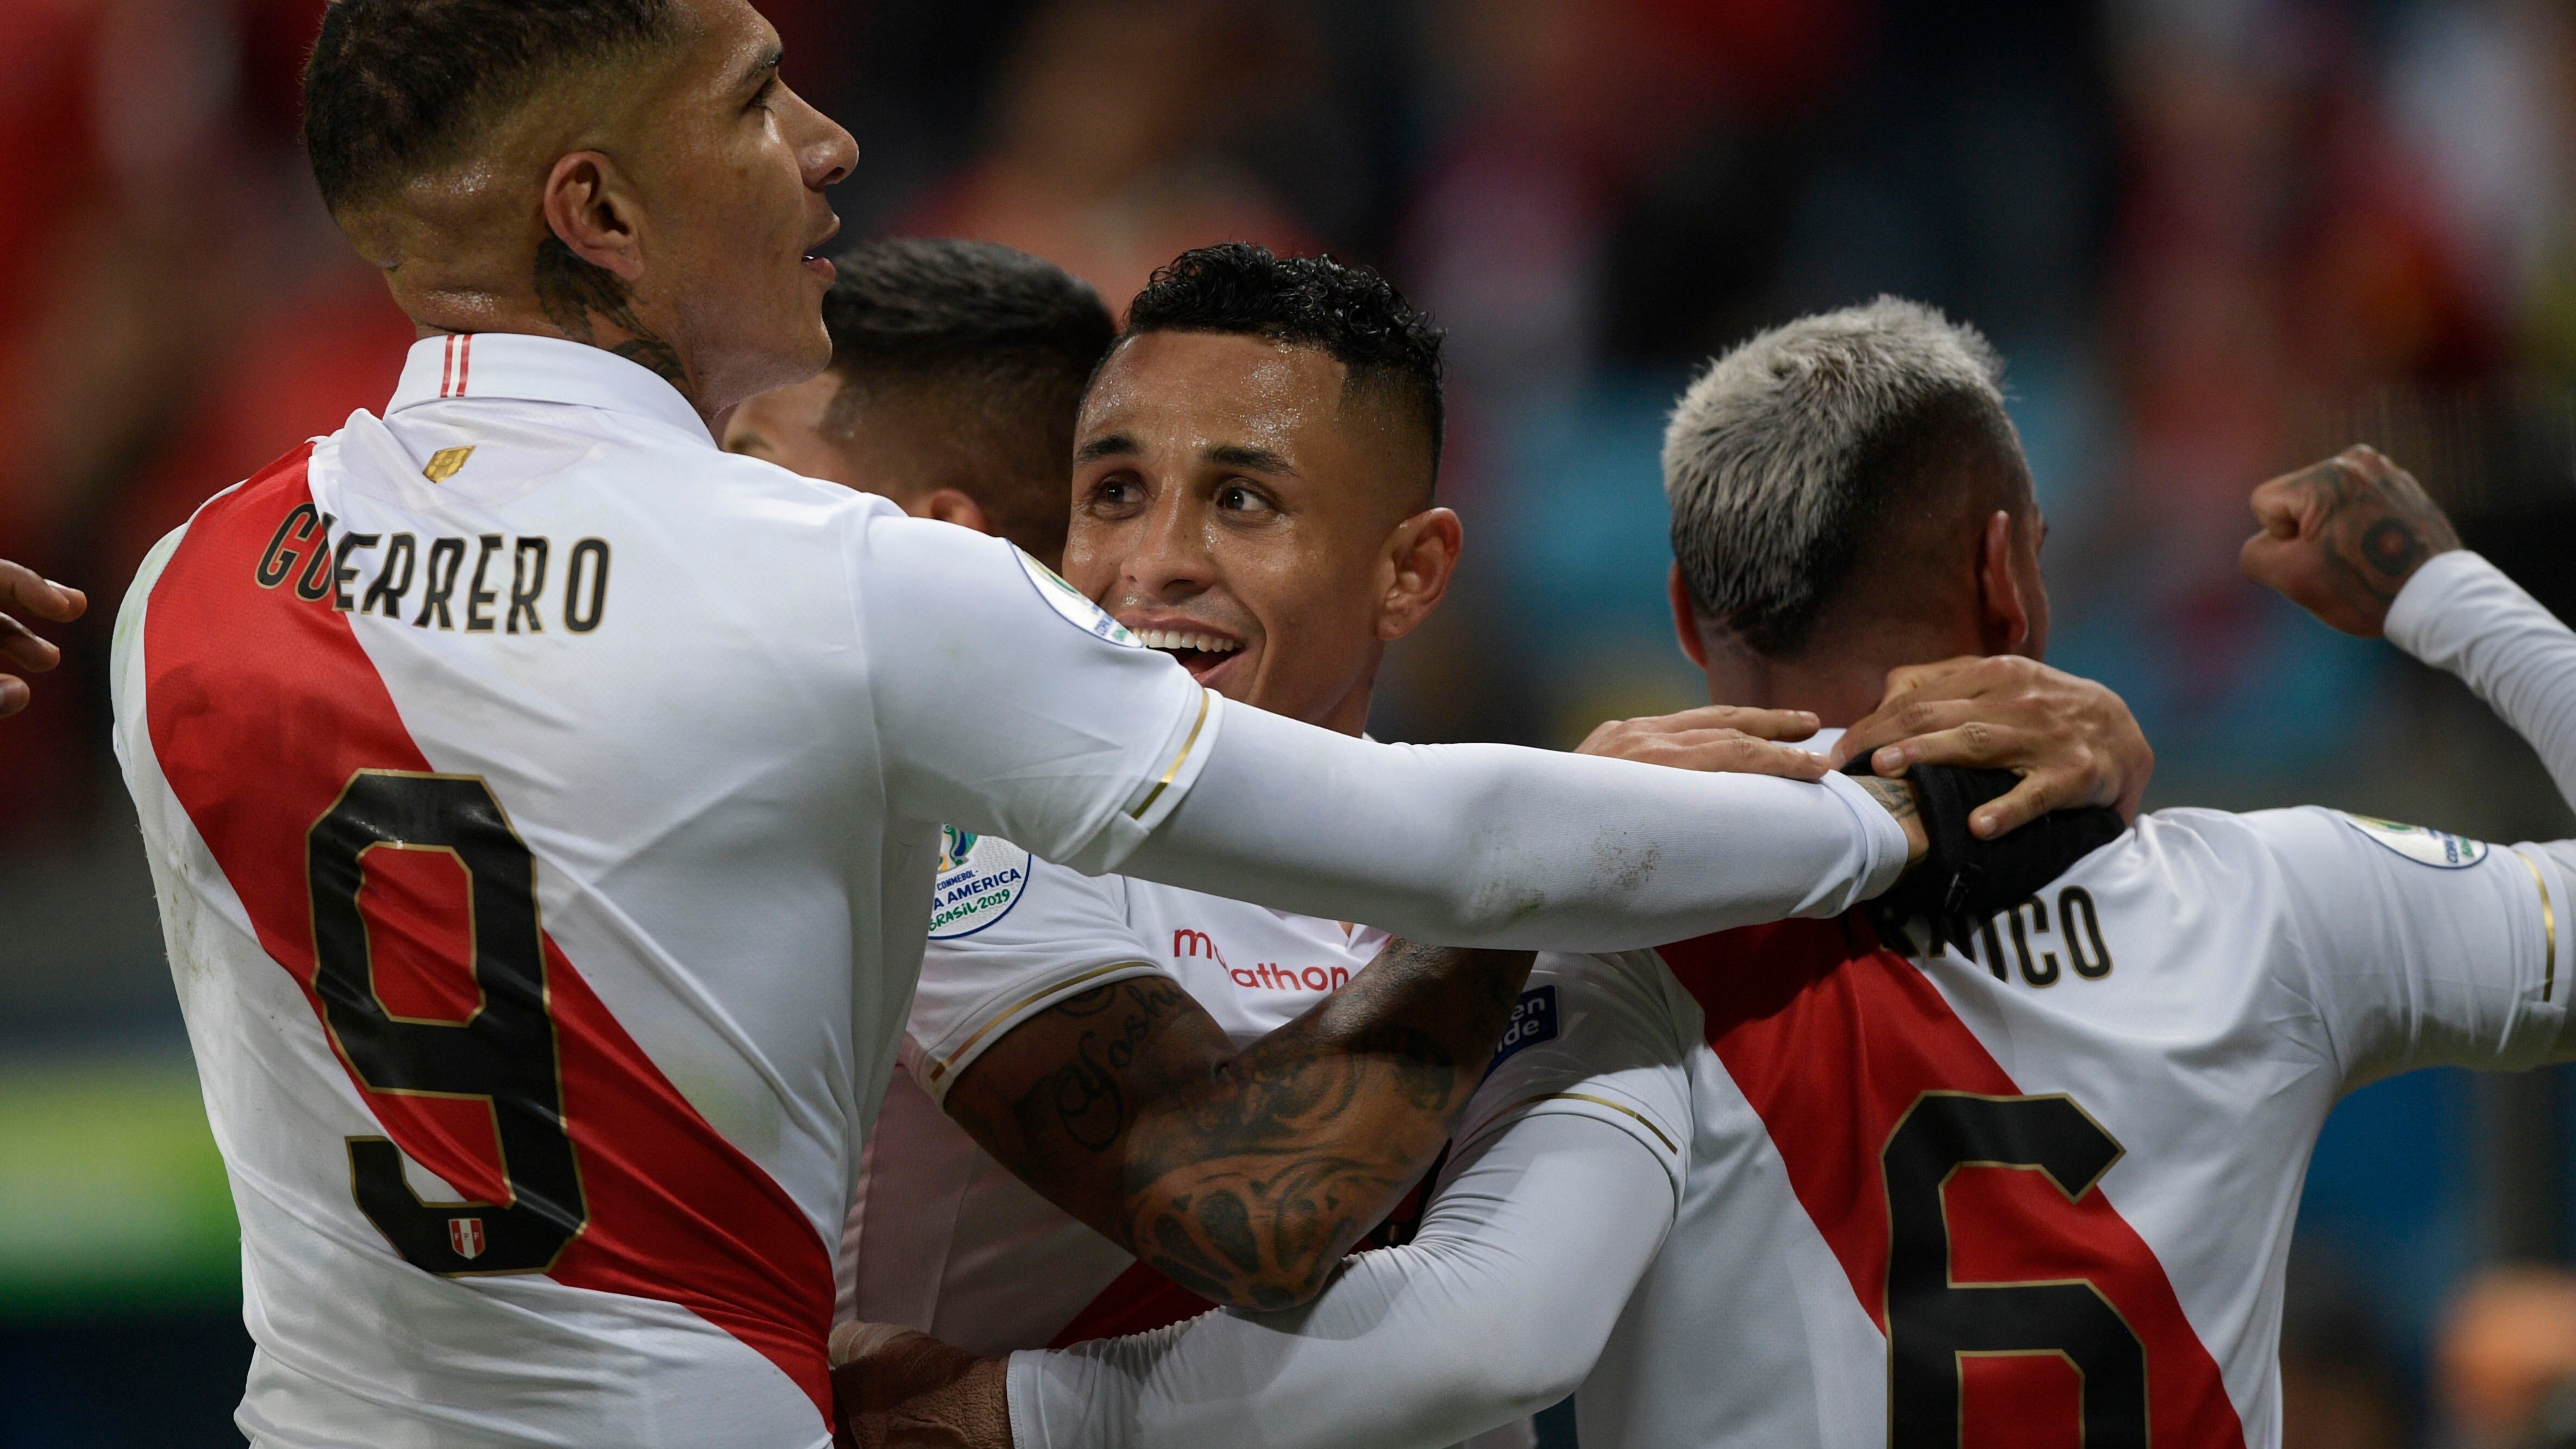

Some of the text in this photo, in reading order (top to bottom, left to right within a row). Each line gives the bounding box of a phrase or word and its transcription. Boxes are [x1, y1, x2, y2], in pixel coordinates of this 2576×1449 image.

[254, 502, 611, 636] GUERRERO
[948, 868, 1022, 904] AMERICA
[976, 889, 1011, 909] 2019
[305, 767, 591, 1278] 9
[1879, 1090, 2151, 1449] 6
